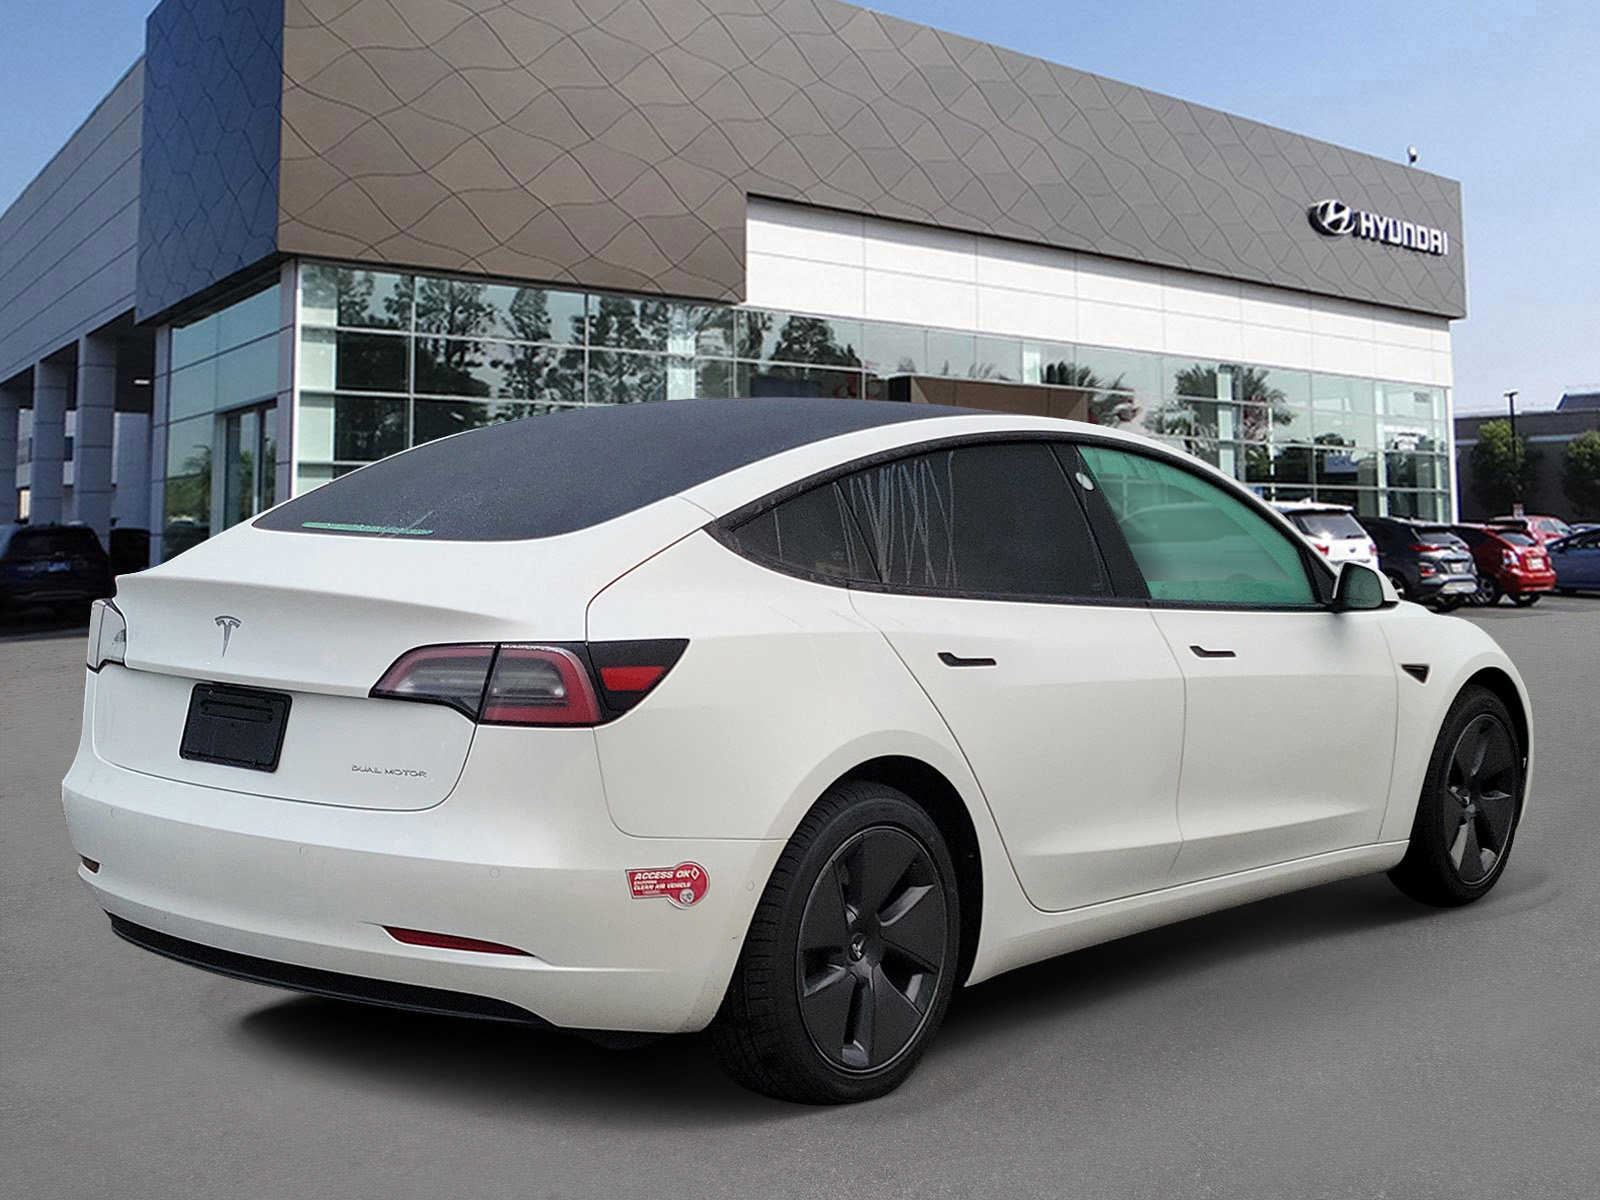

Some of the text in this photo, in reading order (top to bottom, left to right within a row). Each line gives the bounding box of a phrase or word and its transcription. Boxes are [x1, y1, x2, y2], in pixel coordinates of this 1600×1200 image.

[1360, 211, 1448, 255] HYUNDAI
[351, 764, 427, 778] DUAL MOTOR
[634, 870, 690, 880] ACCESS OK
